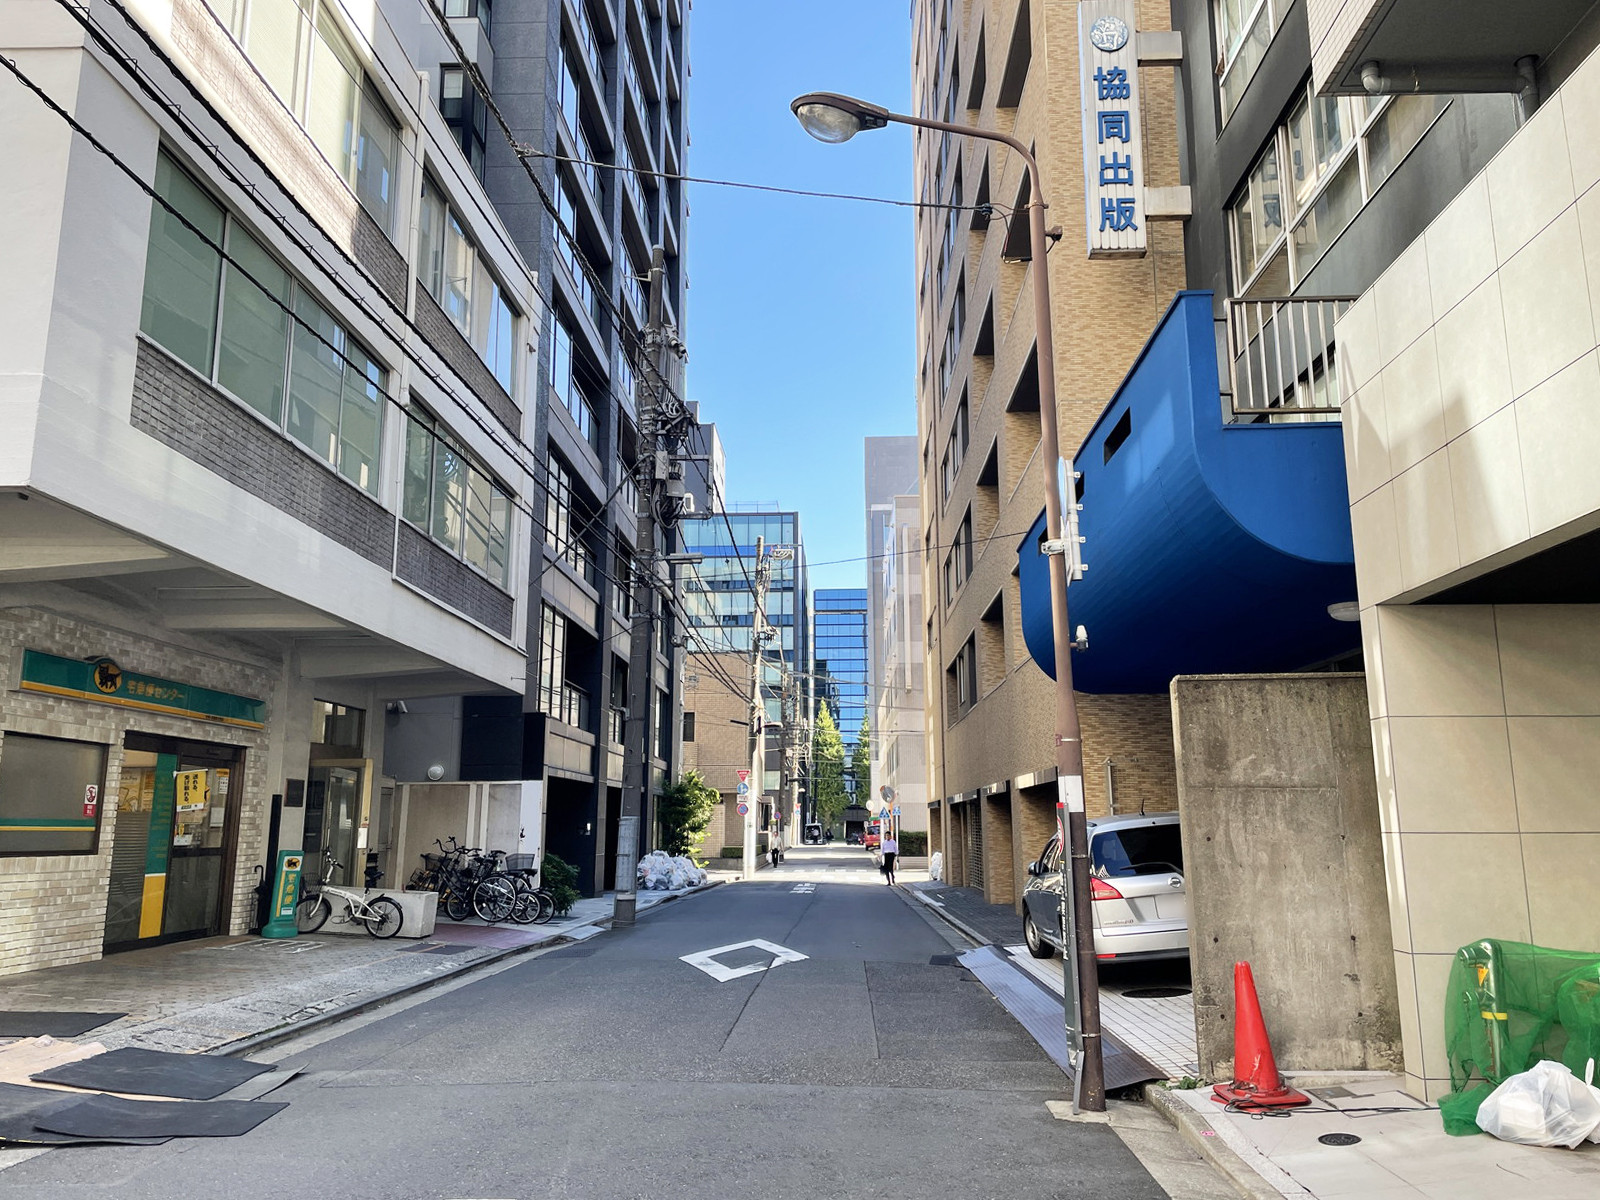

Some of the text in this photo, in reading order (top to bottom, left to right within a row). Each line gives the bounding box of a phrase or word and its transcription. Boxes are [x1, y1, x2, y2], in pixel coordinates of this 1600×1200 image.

[1093, 66, 1138, 232] 協同出版
[126, 680, 185, 701] 宅急便センター
